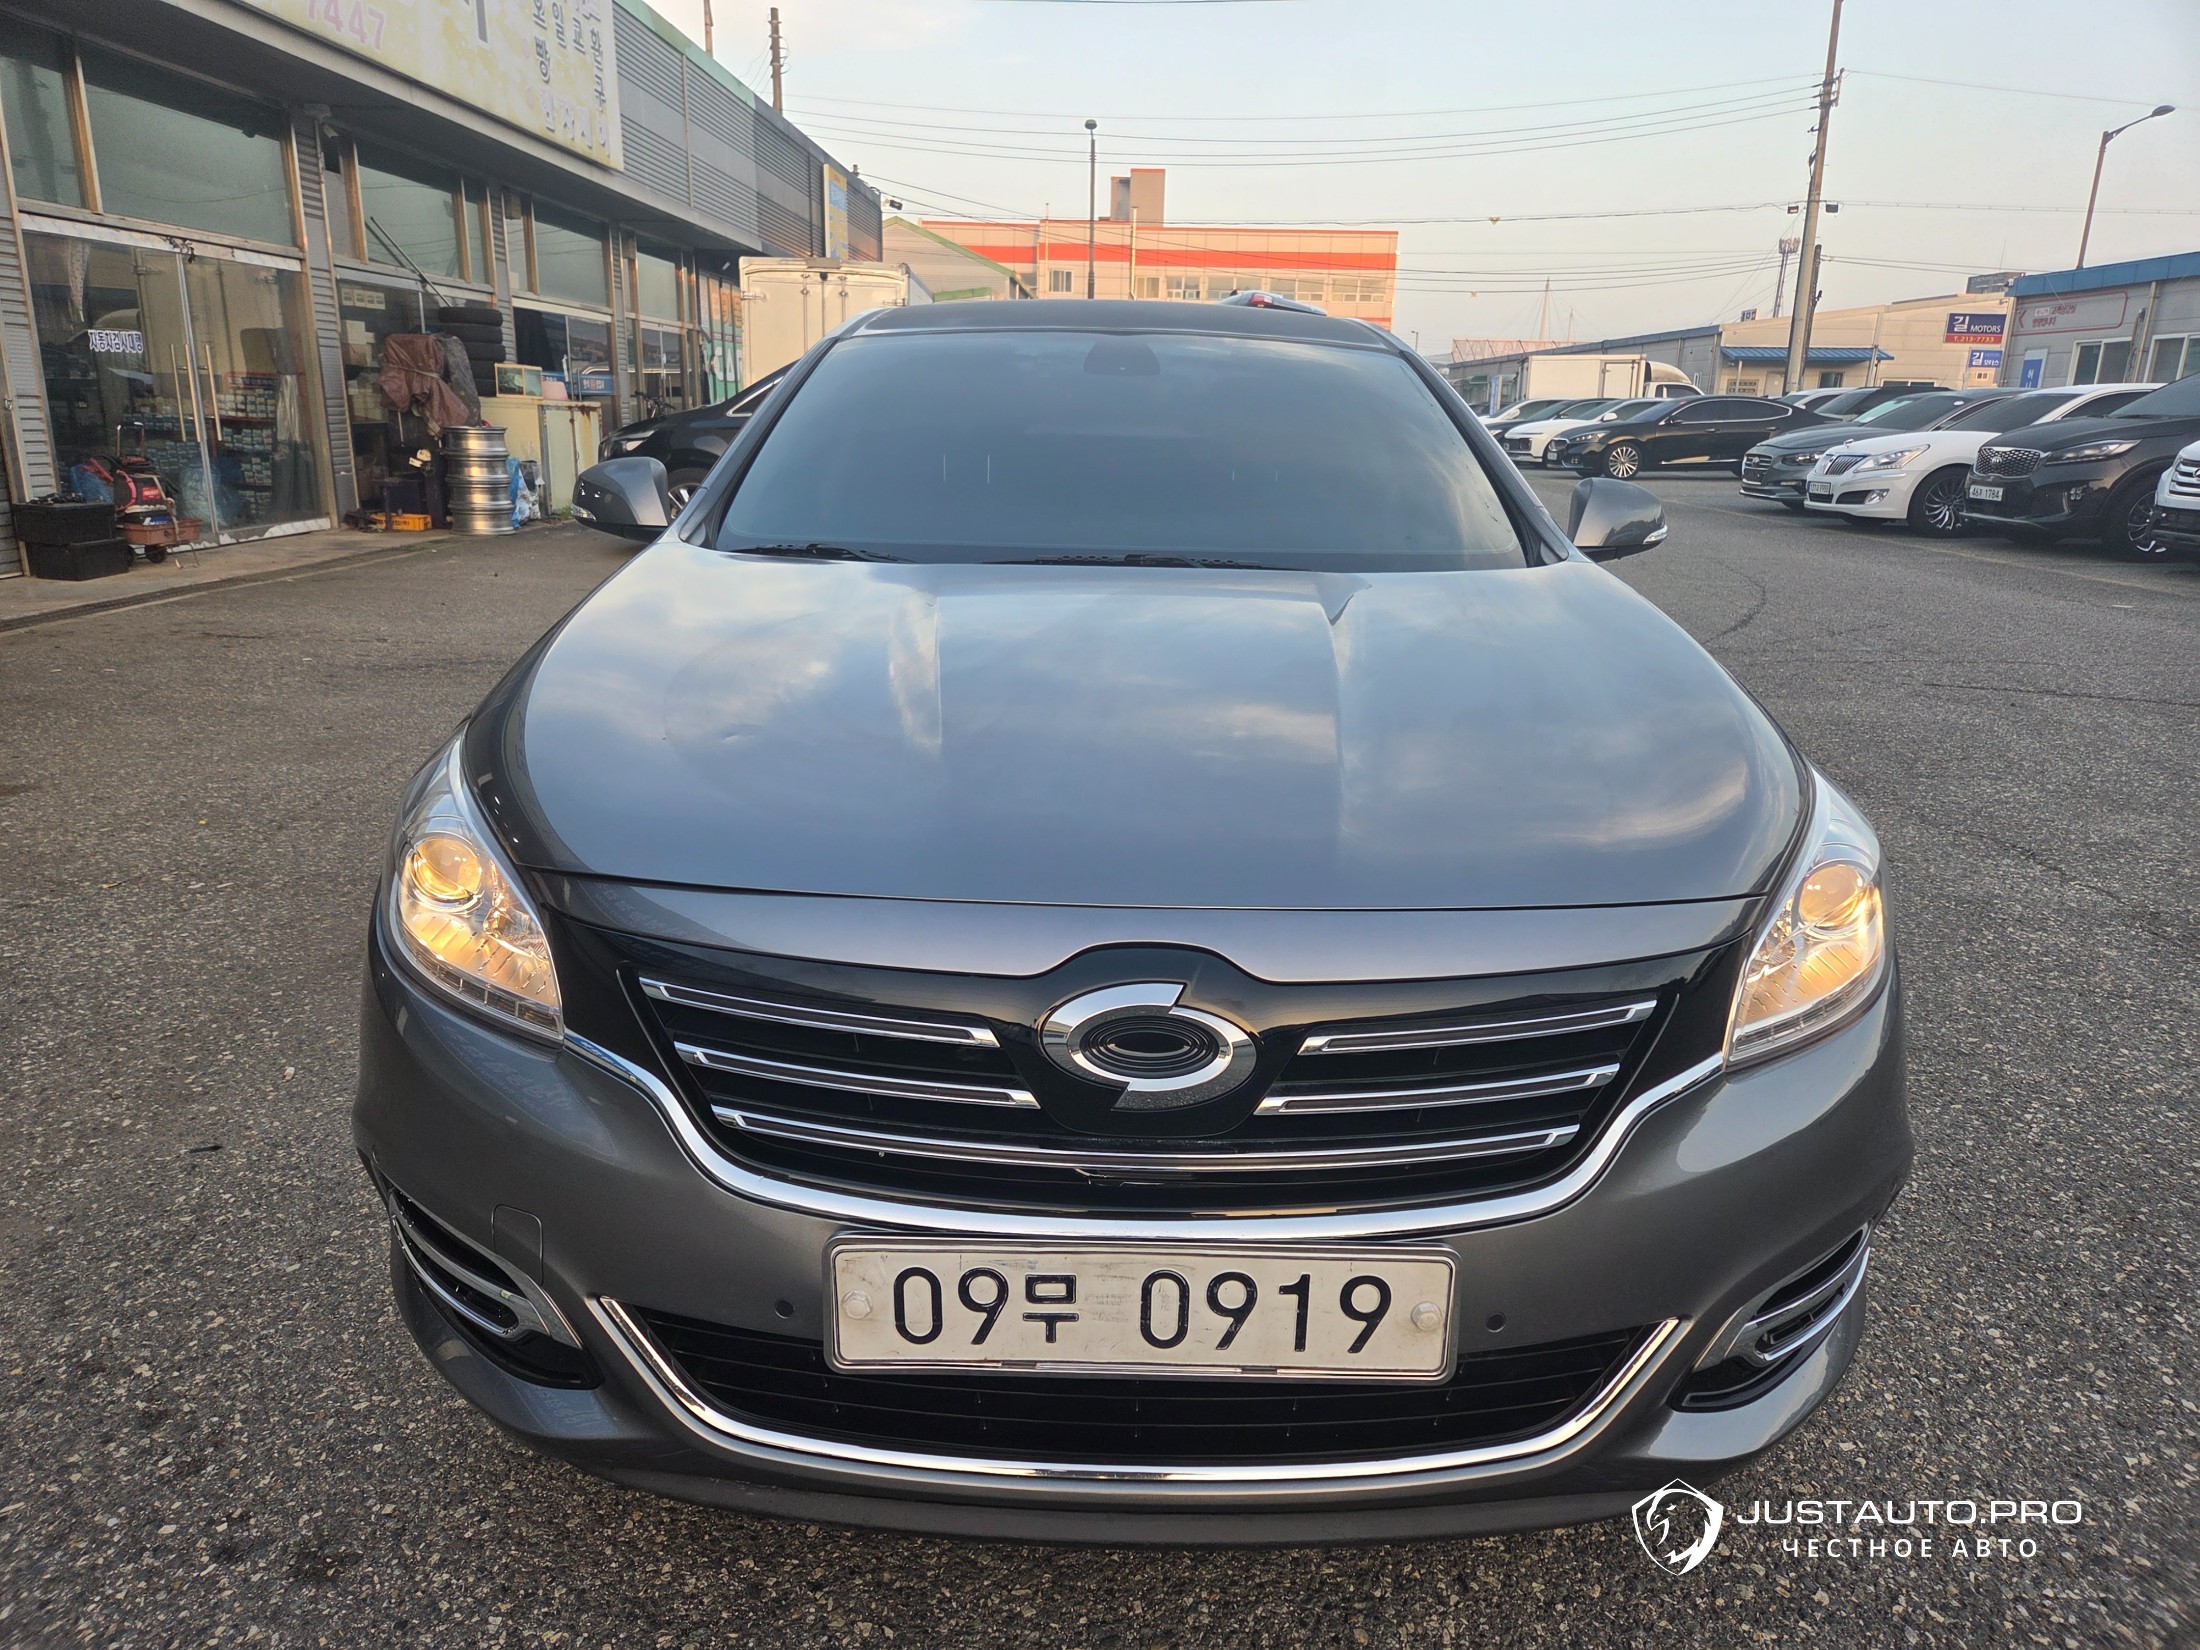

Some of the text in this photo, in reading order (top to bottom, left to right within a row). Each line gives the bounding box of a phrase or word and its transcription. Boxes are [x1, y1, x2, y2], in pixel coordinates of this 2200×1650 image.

[1953, 316, 2001, 333] 길 MOTORS
[1972, 352, 1984, 366] 길
[893, 1266, 1392, 1354] 09무 0919
